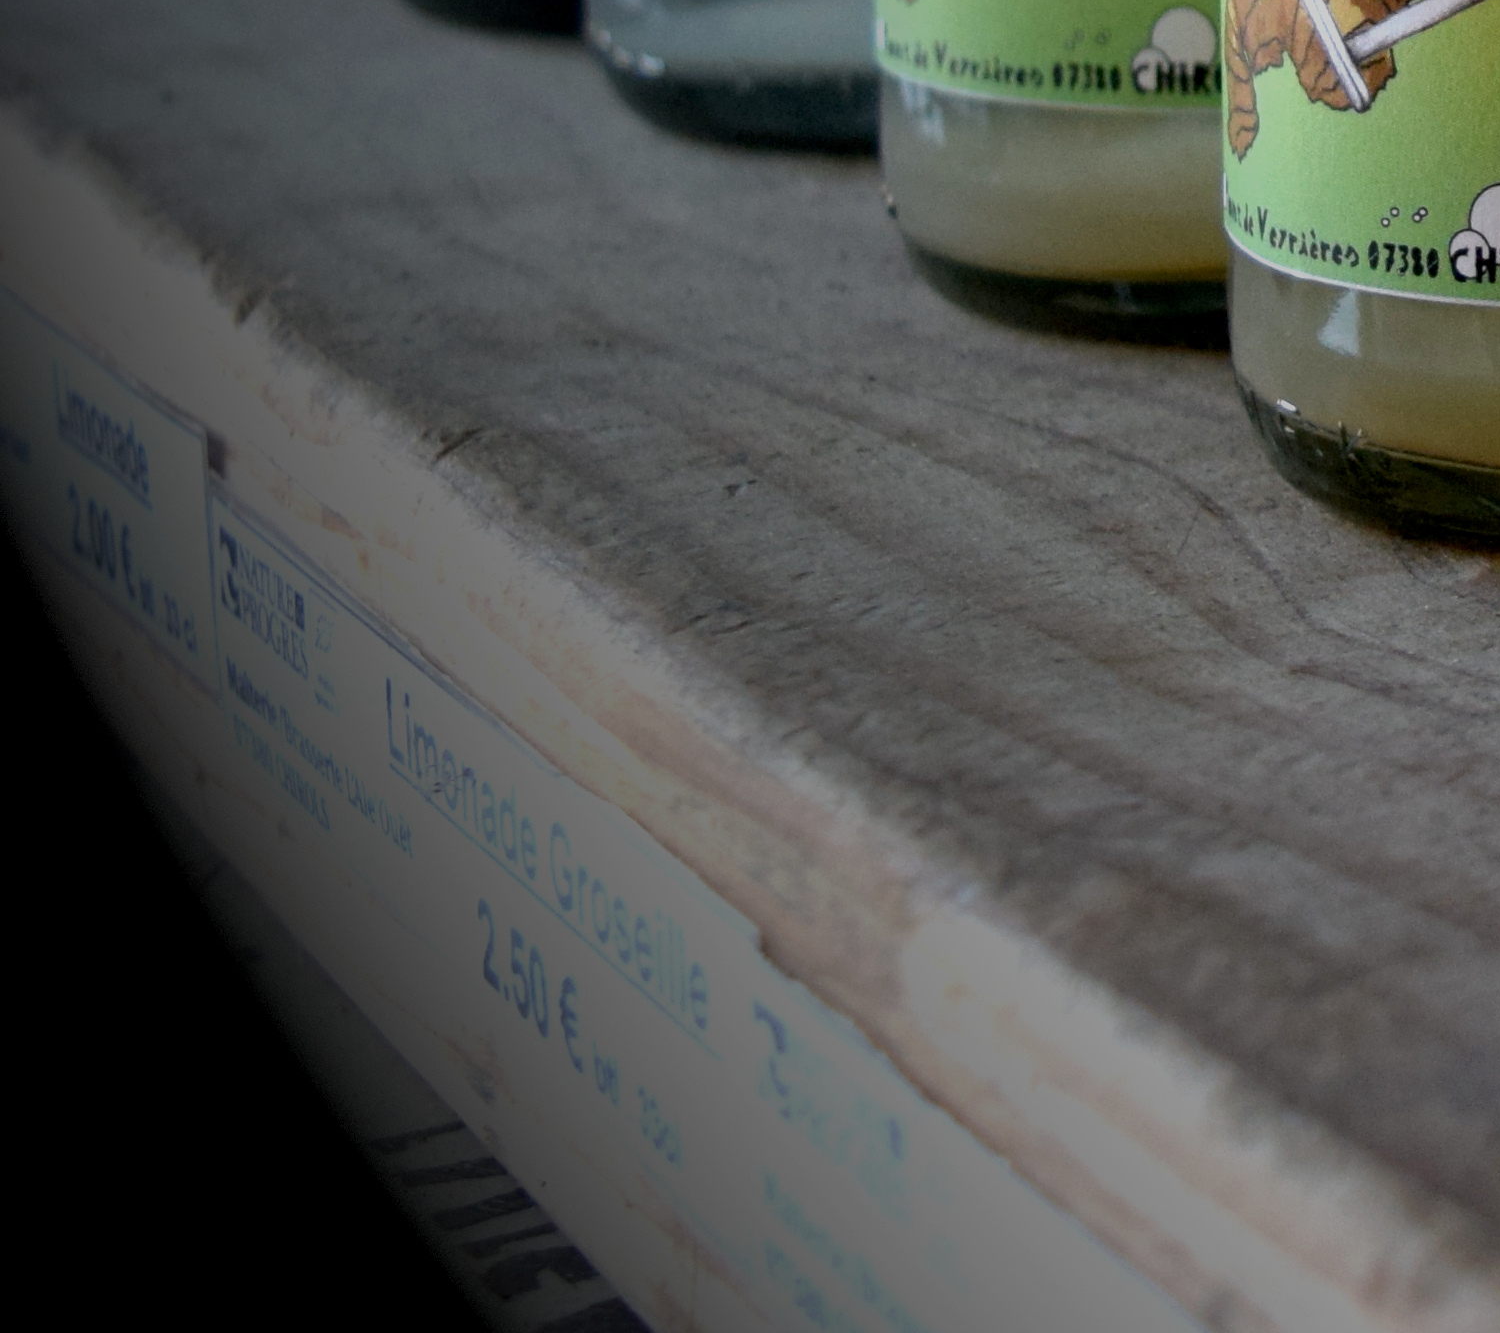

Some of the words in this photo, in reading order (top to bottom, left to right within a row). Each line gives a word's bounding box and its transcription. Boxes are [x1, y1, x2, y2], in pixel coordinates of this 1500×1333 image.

[385, 677, 538, 882] Limonade
[549, 822, 709, 1032] Groseille
[477, 898, 549, 1039] 2.50
